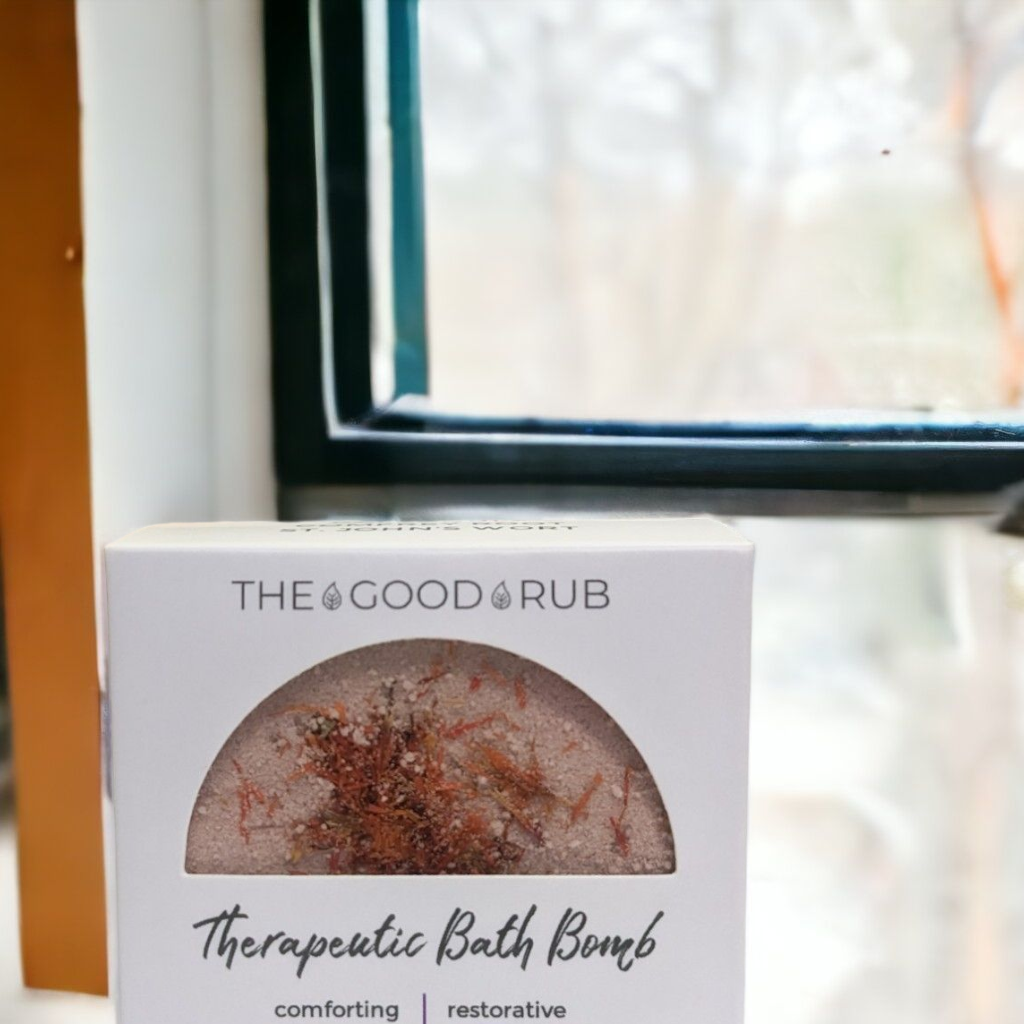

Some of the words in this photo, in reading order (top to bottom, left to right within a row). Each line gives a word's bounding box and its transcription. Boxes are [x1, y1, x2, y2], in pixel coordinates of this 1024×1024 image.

[231, 580, 314, 611] THE
[349, 579, 484, 611] GOOD
[520, 579, 611, 610] RUB
[192, 903, 428, 979] Therapeutic
[435, 903, 538, 972] Bath
[546, 907, 665, 973] Bomb
[274, 999, 400, 1023] comforting
[447, 1000, 567, 1019] restorative
